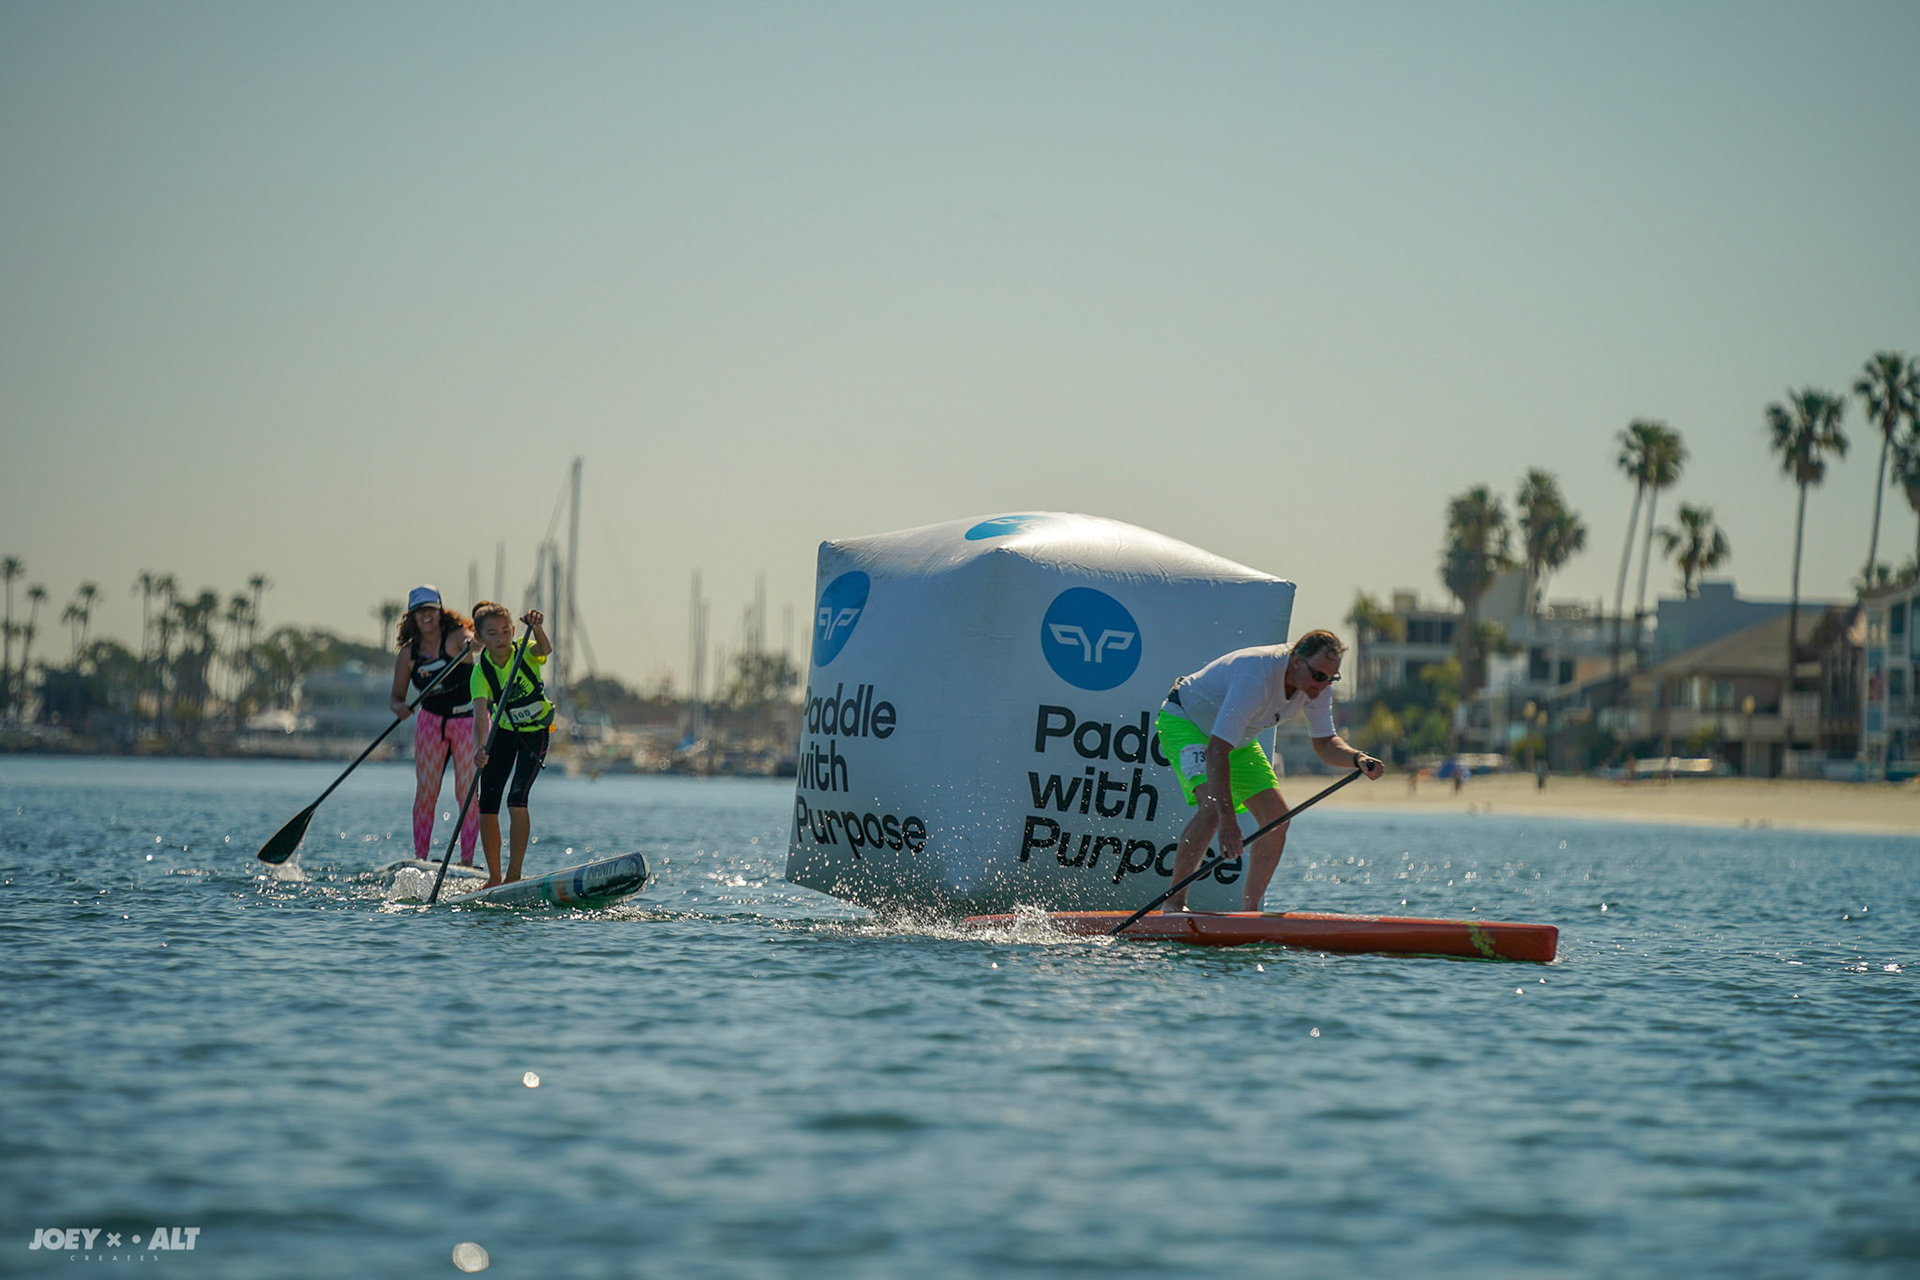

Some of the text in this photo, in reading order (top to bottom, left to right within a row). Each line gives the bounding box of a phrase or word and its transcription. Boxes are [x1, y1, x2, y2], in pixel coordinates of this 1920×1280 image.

[513, 709, 531, 721] 100
[1028, 766, 1159, 821] with
[796, 795, 927, 860] Purpose
